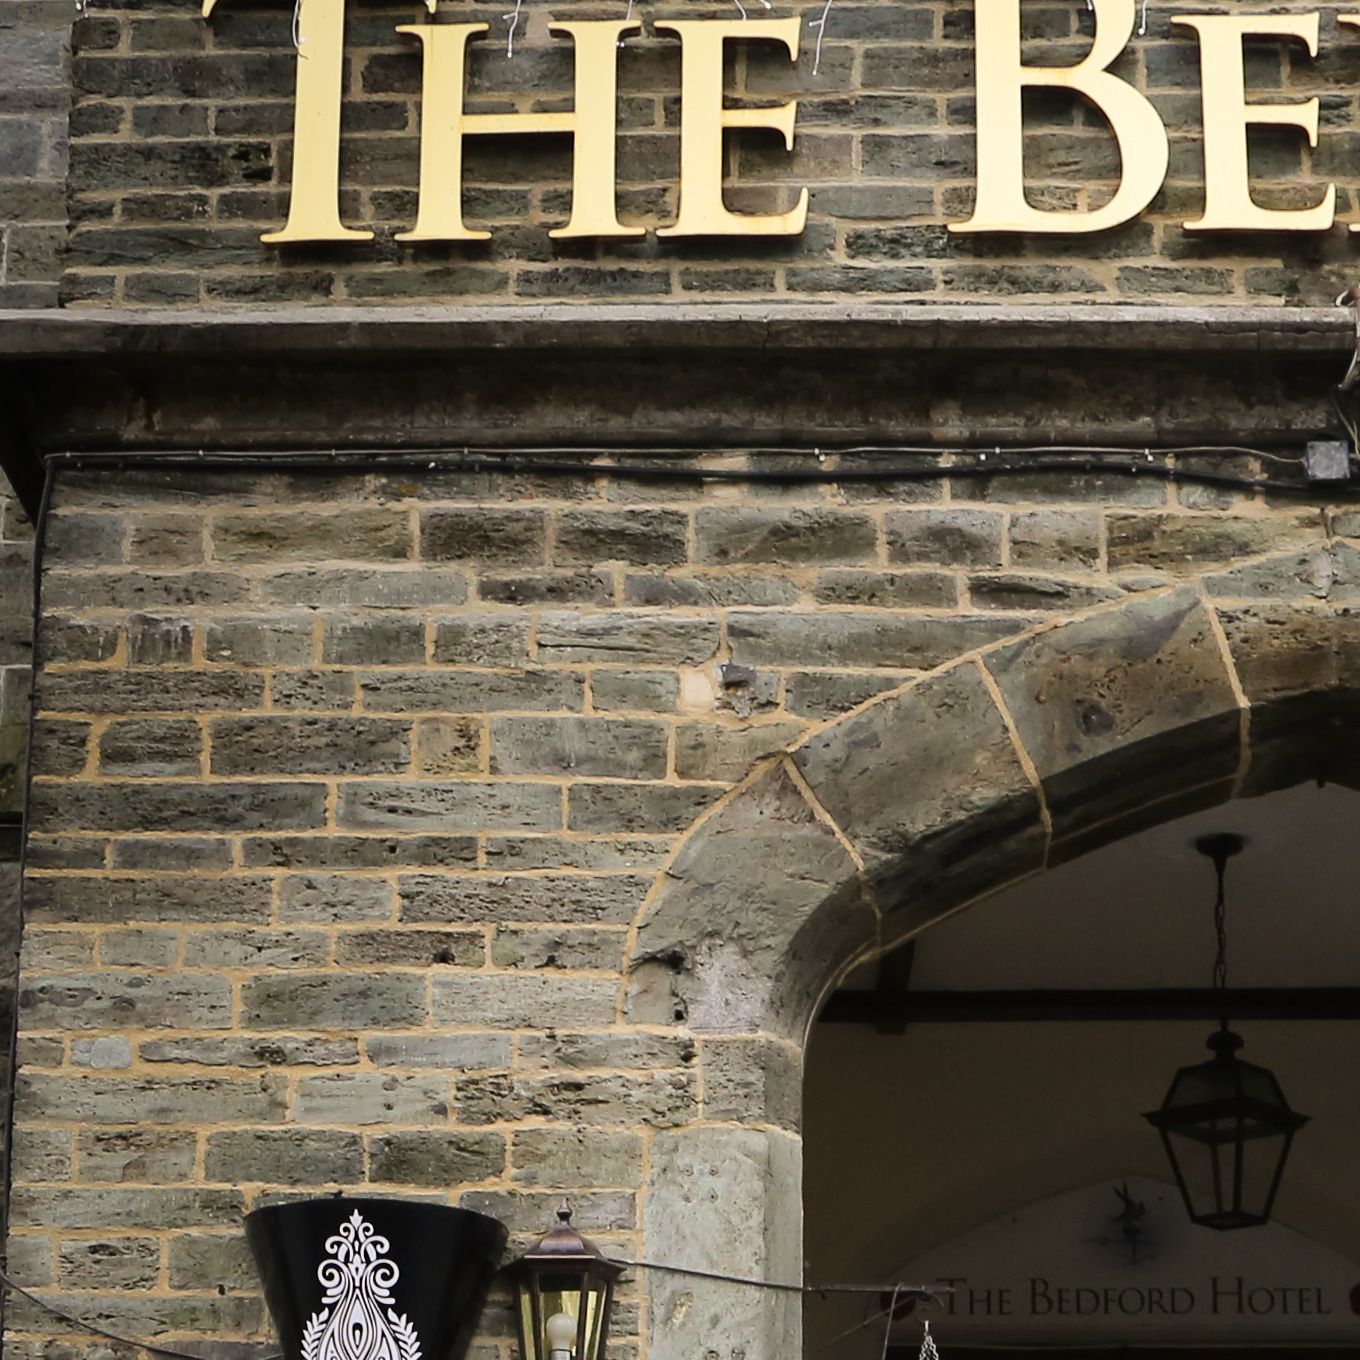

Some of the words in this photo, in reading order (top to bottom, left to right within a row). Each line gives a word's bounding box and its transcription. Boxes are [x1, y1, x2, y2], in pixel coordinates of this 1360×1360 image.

[203, 0, 809, 242] THE
[936, 1277, 1012, 1316] THE
[1029, 1277, 1195, 1316] BEDFORD
[1210, 1276, 1332, 1316] HOTEL
